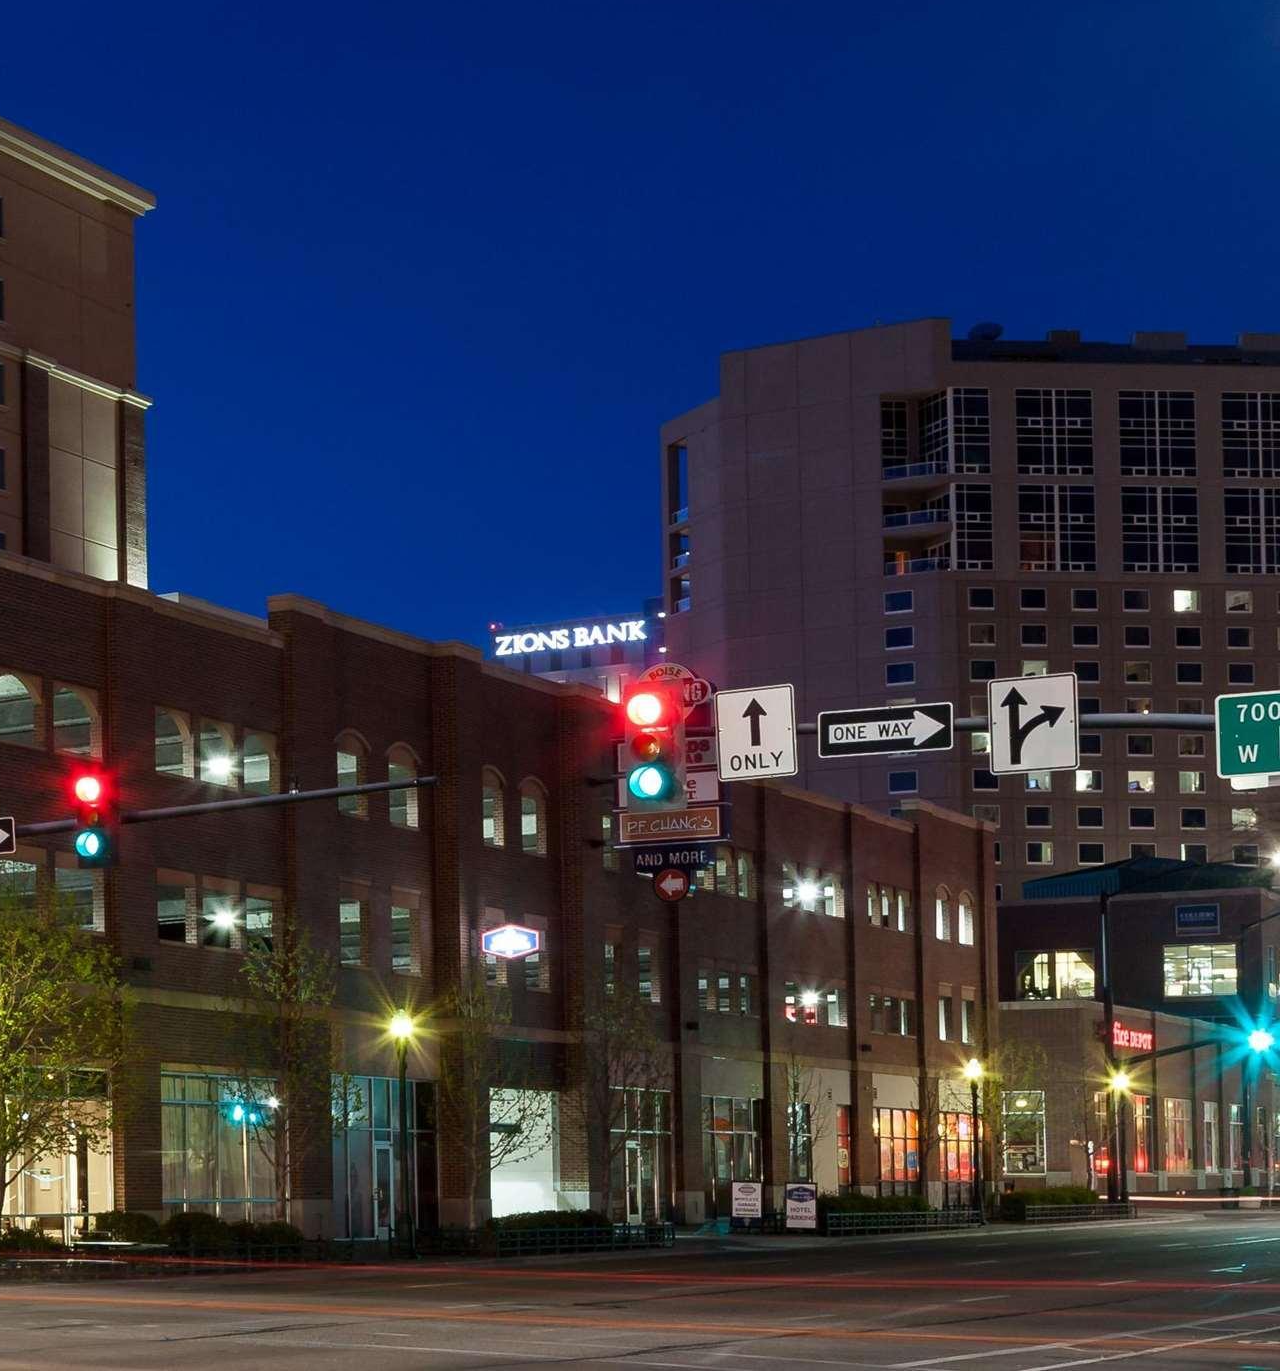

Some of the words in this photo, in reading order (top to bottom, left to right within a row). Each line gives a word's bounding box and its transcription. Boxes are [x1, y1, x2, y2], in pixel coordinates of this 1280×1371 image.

[495, 629, 570, 656] ZIONS
[573, 620, 647, 647] BANK
[649, 667, 682, 680] BOISE
[1236, 701, 1280, 723] 700
[833, 725, 867, 741] ONE
[878, 722, 912, 738] WAY
[730, 750, 784, 771] ONLY
[1238, 744, 1259, 763] W
[636, 853, 663, 866] AND
[669, 850, 708, 864] MORE
[1130, 1031, 1152, 1050] DEPOT
